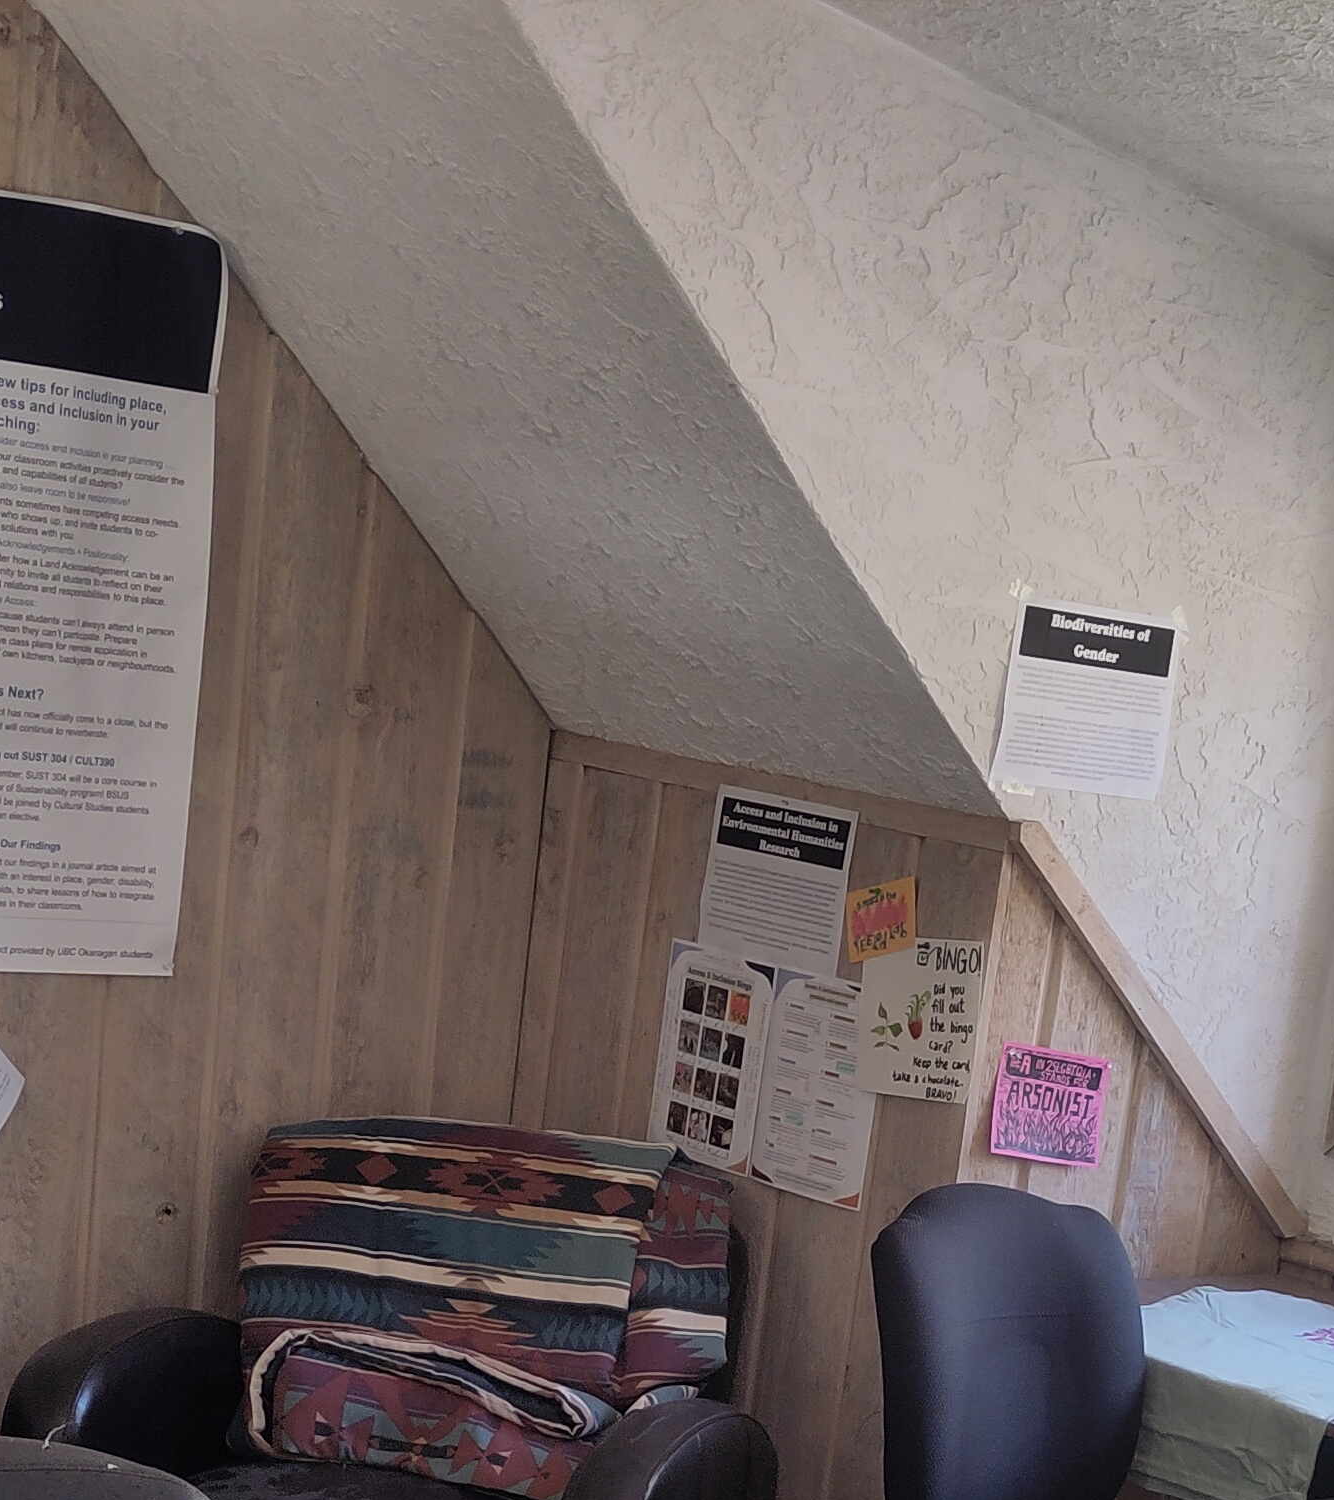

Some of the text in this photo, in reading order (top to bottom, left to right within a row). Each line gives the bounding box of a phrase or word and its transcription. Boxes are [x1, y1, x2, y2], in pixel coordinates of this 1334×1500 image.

[20, 377, 46, 395] tips
[50, 381, 69, 397] for
[73, 385, 126, 410] including
[129, 396, 166, 416] place,
[29, 401, 55, 415] and
[59, 403, 113, 424] inclusion
[115, 412, 127, 426] in
[130, 417, 160, 431] your
[1051, 613, 1151, 643] Biodiversities of
[1073, 643, 1120, 664] Gender
[7, 685, 44, 700] Next?
[3, 751, 19, 760] out
[21, 750, 49, 762] SUST
[50, 753, 67, 763] 304
[74, 755, 115, 767] CULT390
[733, 802, 839, 833] Access and Inclusion in
[722, 815, 845, 850] Environmental Humanities
[0, 838, 18, 848] Our
[19, 839, 61, 853] Findings
[759, 839, 801, 858] Research
[935, 940, 981, 977] BINGO!
[933, 983, 965, 996] Did you
[932, 999, 965, 1014] fill out
[930, 1016, 973, 1043] the bingo
[929, 1040, 953, 1053] card?
[935, 1057, 948, 1070] the
[951, 1059, 970, 1074] card,
[893, 1070, 911, 1083] take
[1040, 1071, 1090, 1088] STANDS FOR
[925, 1086, 957, 1101] BRAVO!
[1007, 1081, 1094, 1120] ARSONIST
